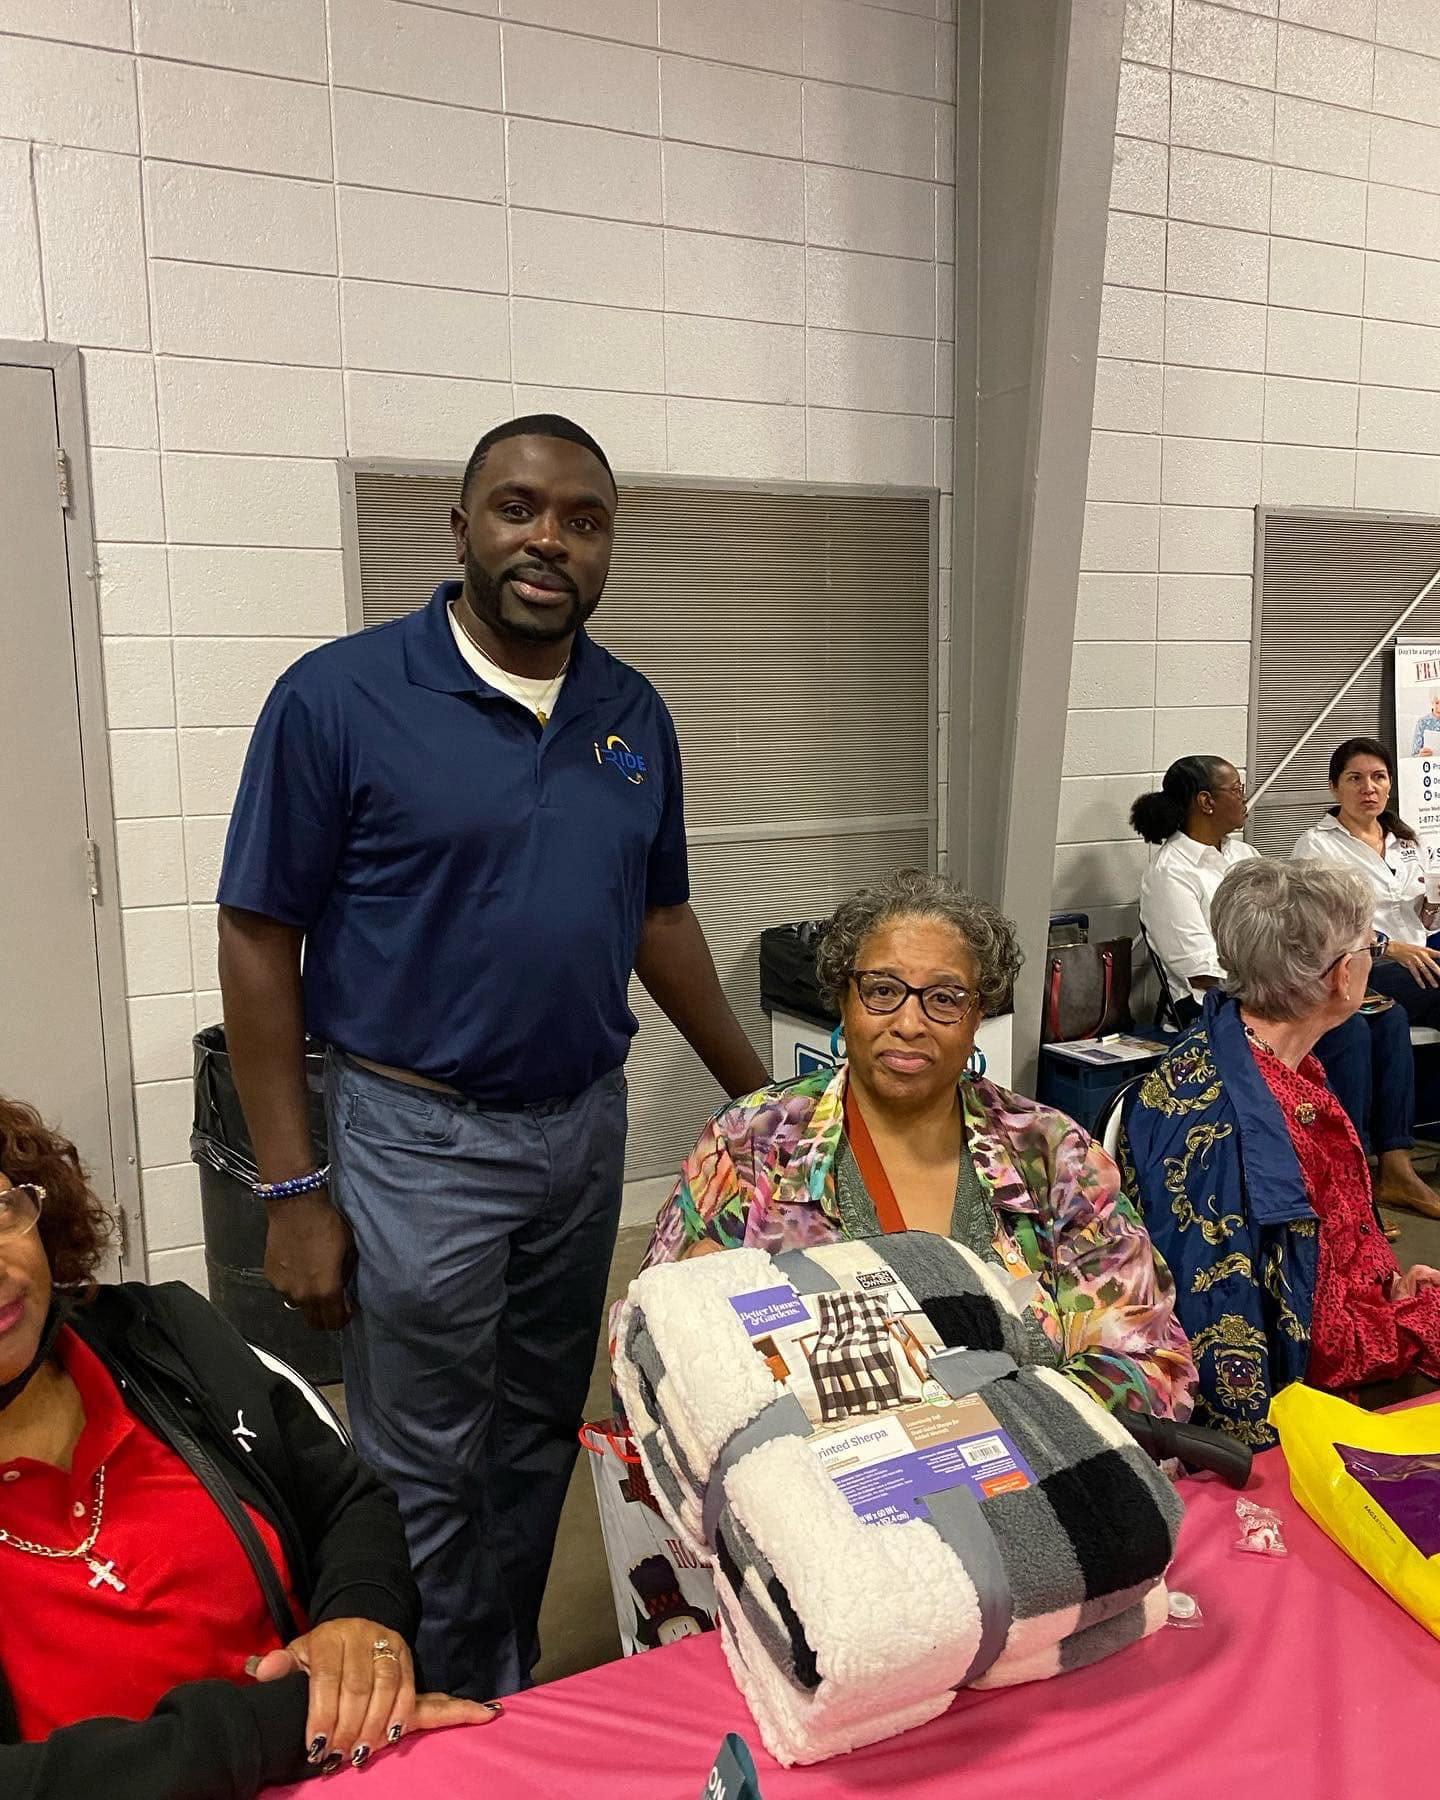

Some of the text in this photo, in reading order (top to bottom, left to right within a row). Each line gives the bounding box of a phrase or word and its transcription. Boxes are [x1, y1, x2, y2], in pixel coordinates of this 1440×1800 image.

[1415, 661, 1440, 680] FRA
[740, 1301, 801, 1321] Better Homes
[818, 1430, 888, 1459] rinted Sherpa
